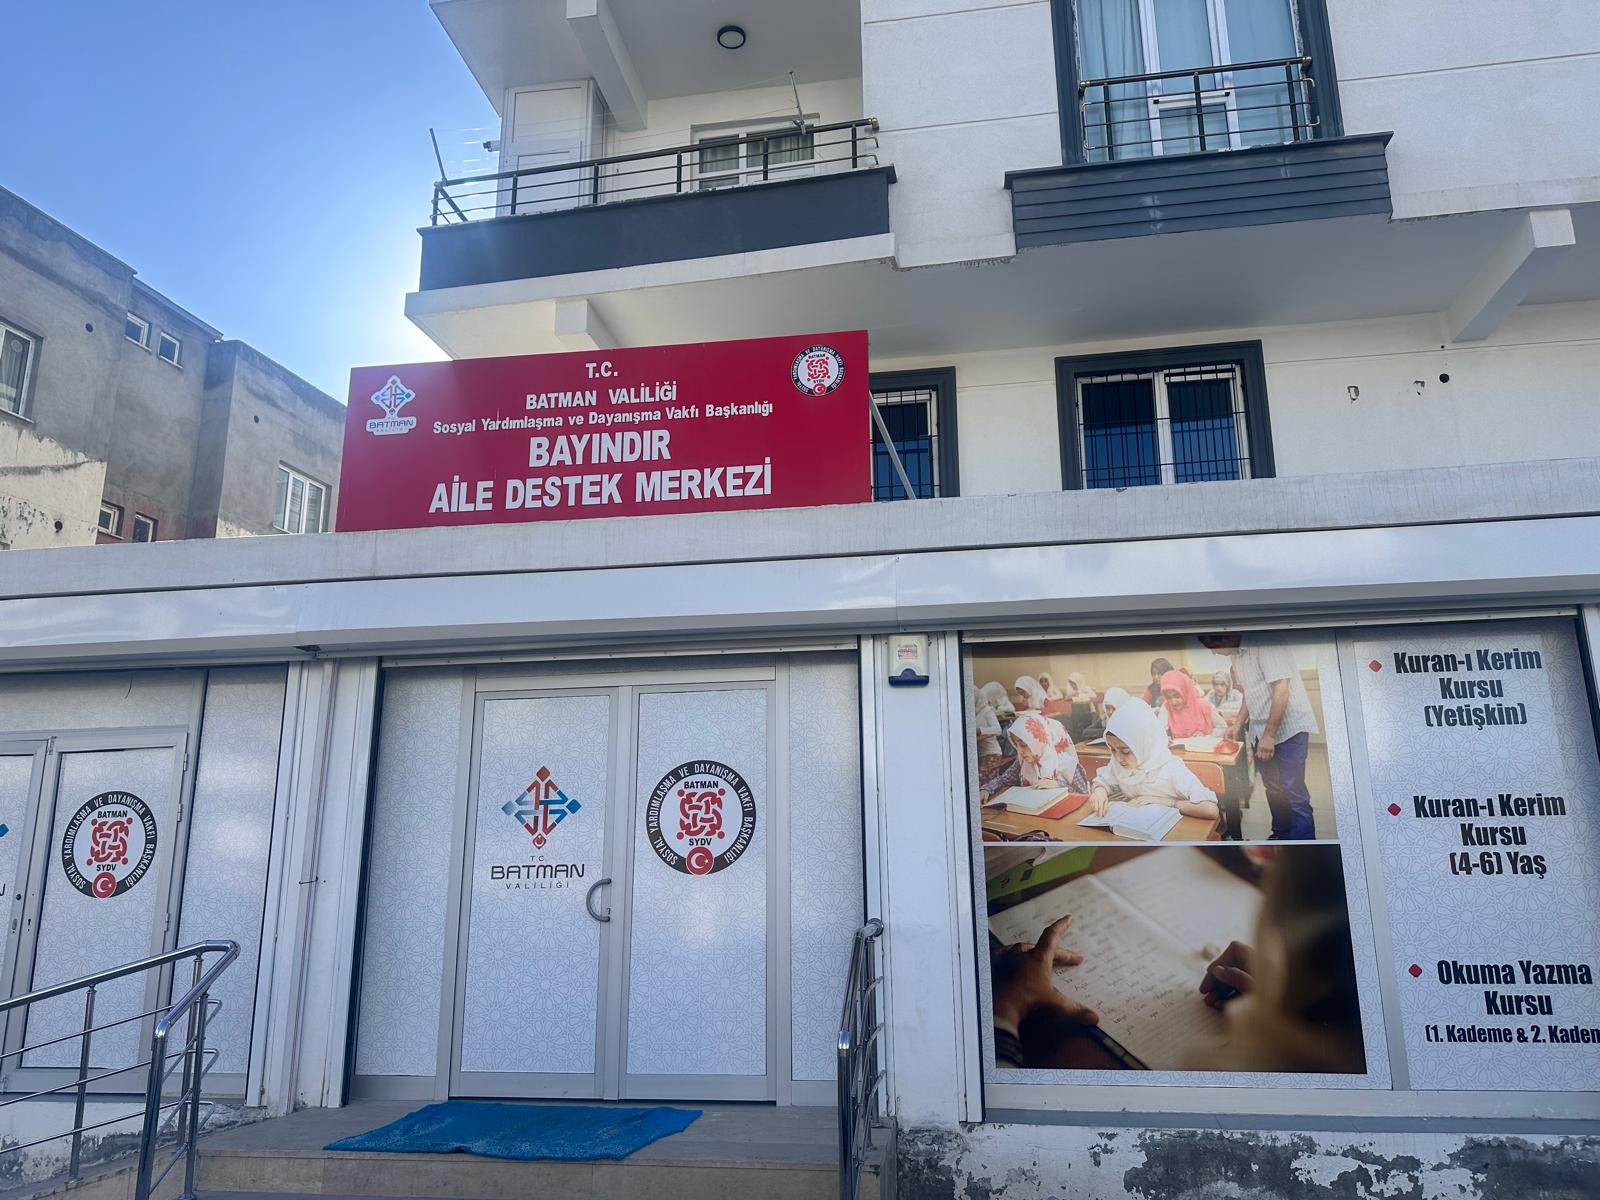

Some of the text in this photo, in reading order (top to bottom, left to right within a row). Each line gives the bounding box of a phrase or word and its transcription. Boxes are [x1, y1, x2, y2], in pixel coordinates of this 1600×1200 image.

[585, 361, 618, 378] T.C.
[526, 381, 677, 410] BATMAN VALİLİĞİ
[369, 419, 414, 429] BATMAN
[433, 400, 773, 435] Sosyal Yardımlaşma ve Dayanışma Vakfı Başkanlığı
[528, 429, 671, 468] BAYINDIR
[428, 456, 772, 514] AİLE DESTEK MERKEZİ
[1394, 648, 1542, 673] Kuran-ı Kerim
[1438, 677, 1504, 699] Kursu
[1424, 702, 1528, 730] (Yetişkin)
[678, 766, 690, 778] VE
[684, 780, 719, 789] BATMAN
[738, 786, 754, 812] VAKFI
[1413, 793, 1566, 818] Kuran-ı Kerim
[97, 810, 128, 818] BATMAN
[66, 862, 86, 889] SOSYAL
[94, 797, 104, 808] VE
[142, 814, 156, 839] VAKFI
[688, 838, 712, 846] SYDV
[724, 816, 754, 864] BAŞKANLIĞI
[1460, 823, 1527, 846] Kursu
[654, 836, 678, 865] SOSYAL
[96, 864, 117, 872] SYDV
[490, 864, 585, 880] BATMAN
[1449, 851, 1547, 879] (4-6) Yaş
[1437, 960, 1593, 985] Okuma Yazma
[1484, 990, 1554, 1016] Kursu
[1446, 1024, 1513, 1042] Kademe
[1516, 1027, 1528, 1043] &
[1530, 1025, 1546, 1044] 2.
